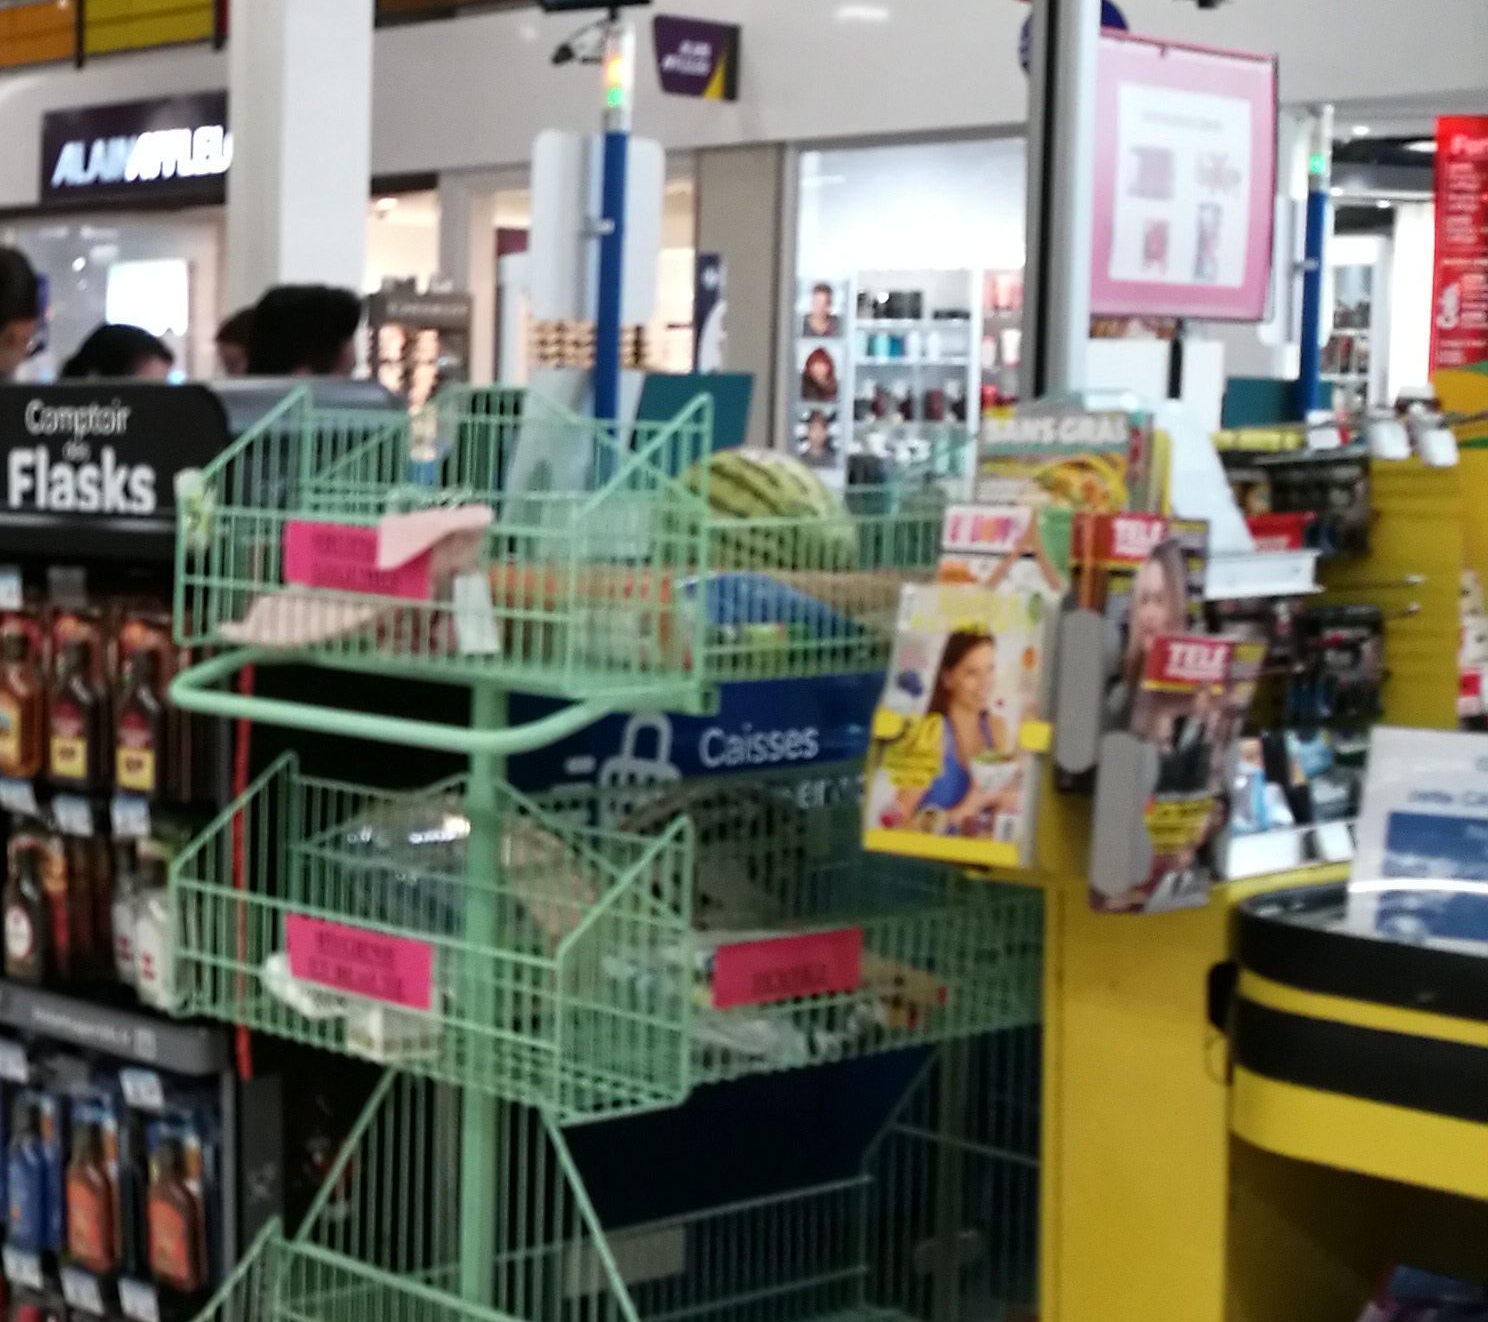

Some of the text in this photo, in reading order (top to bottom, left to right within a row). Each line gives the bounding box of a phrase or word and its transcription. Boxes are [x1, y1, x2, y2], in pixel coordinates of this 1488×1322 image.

[25, 398, 133, 437] Comptoir
[8, 445, 157, 515] Flasks
[699, 721, 820, 769] Caisses
